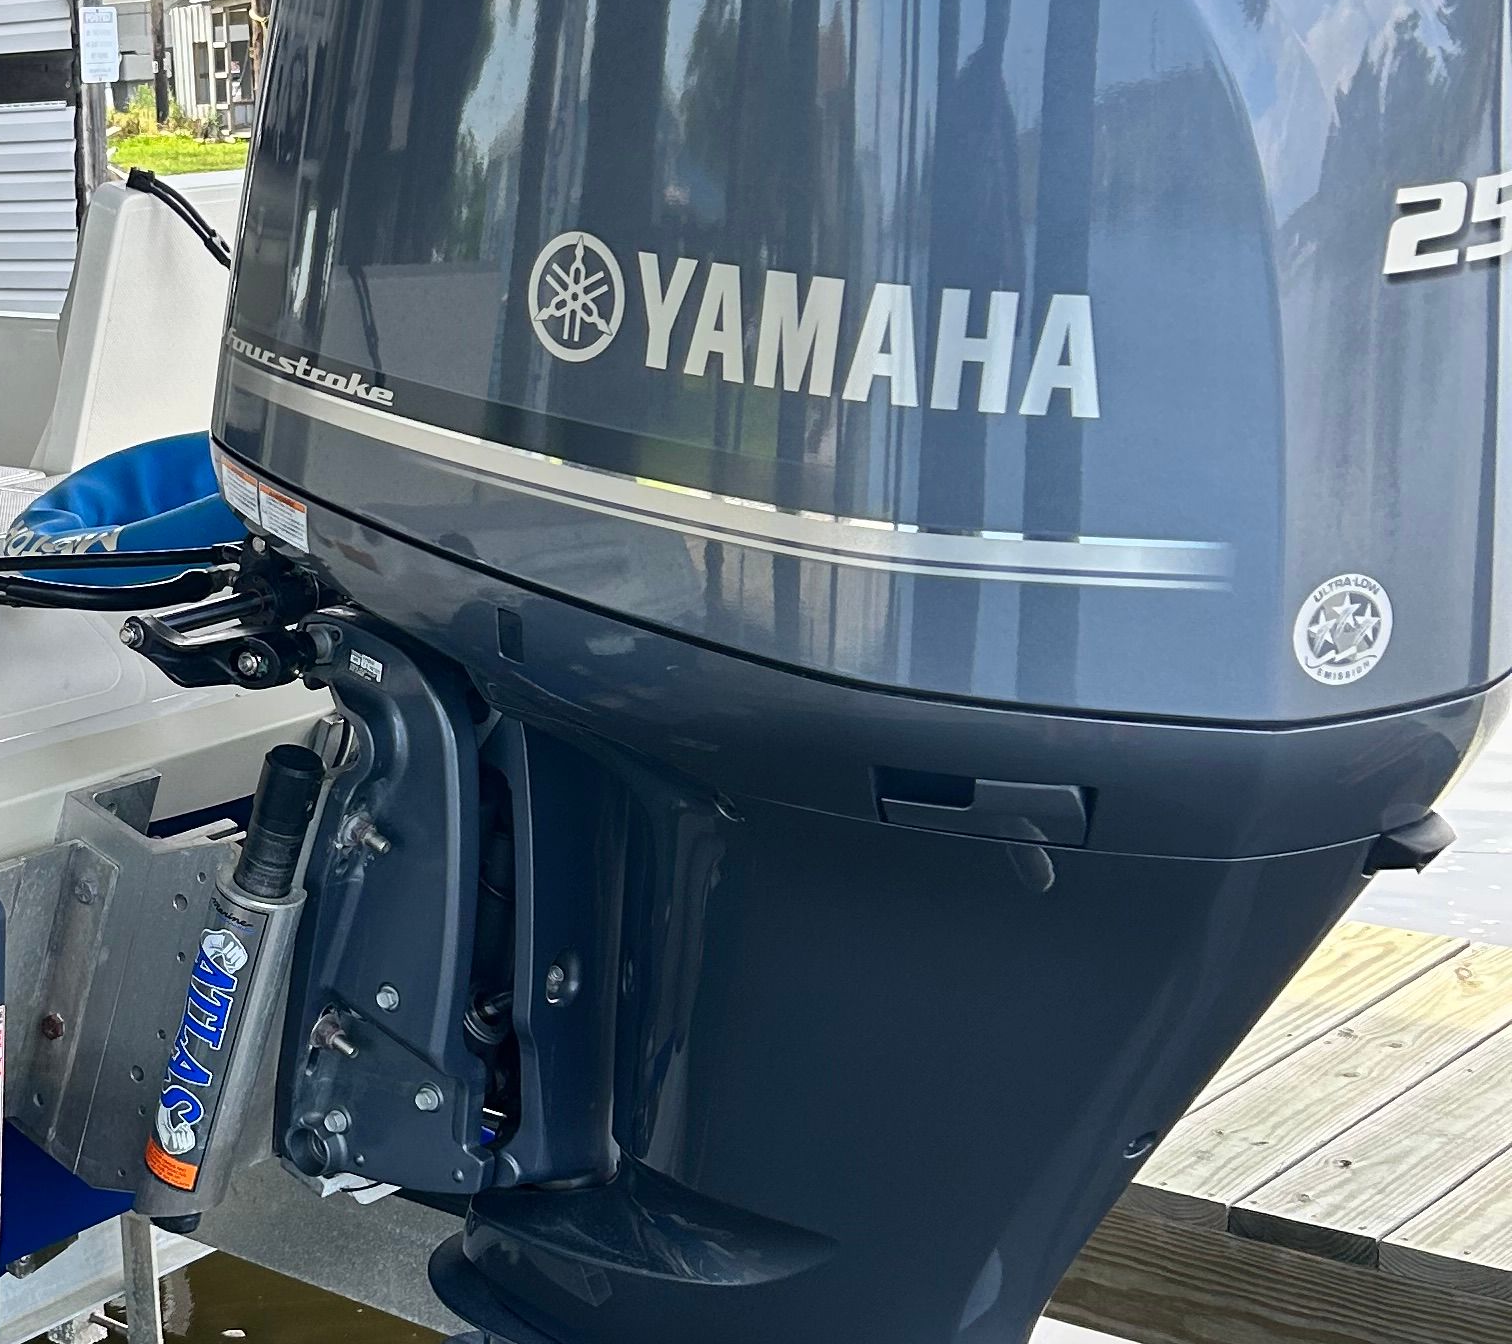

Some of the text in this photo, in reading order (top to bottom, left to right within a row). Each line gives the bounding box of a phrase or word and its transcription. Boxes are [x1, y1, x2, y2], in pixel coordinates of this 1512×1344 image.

[638, 251, 1100, 418] YAMAHA
[1317, 660, 1371, 680] EMISSION
[160, 944, 238, 1129] ATLAS
